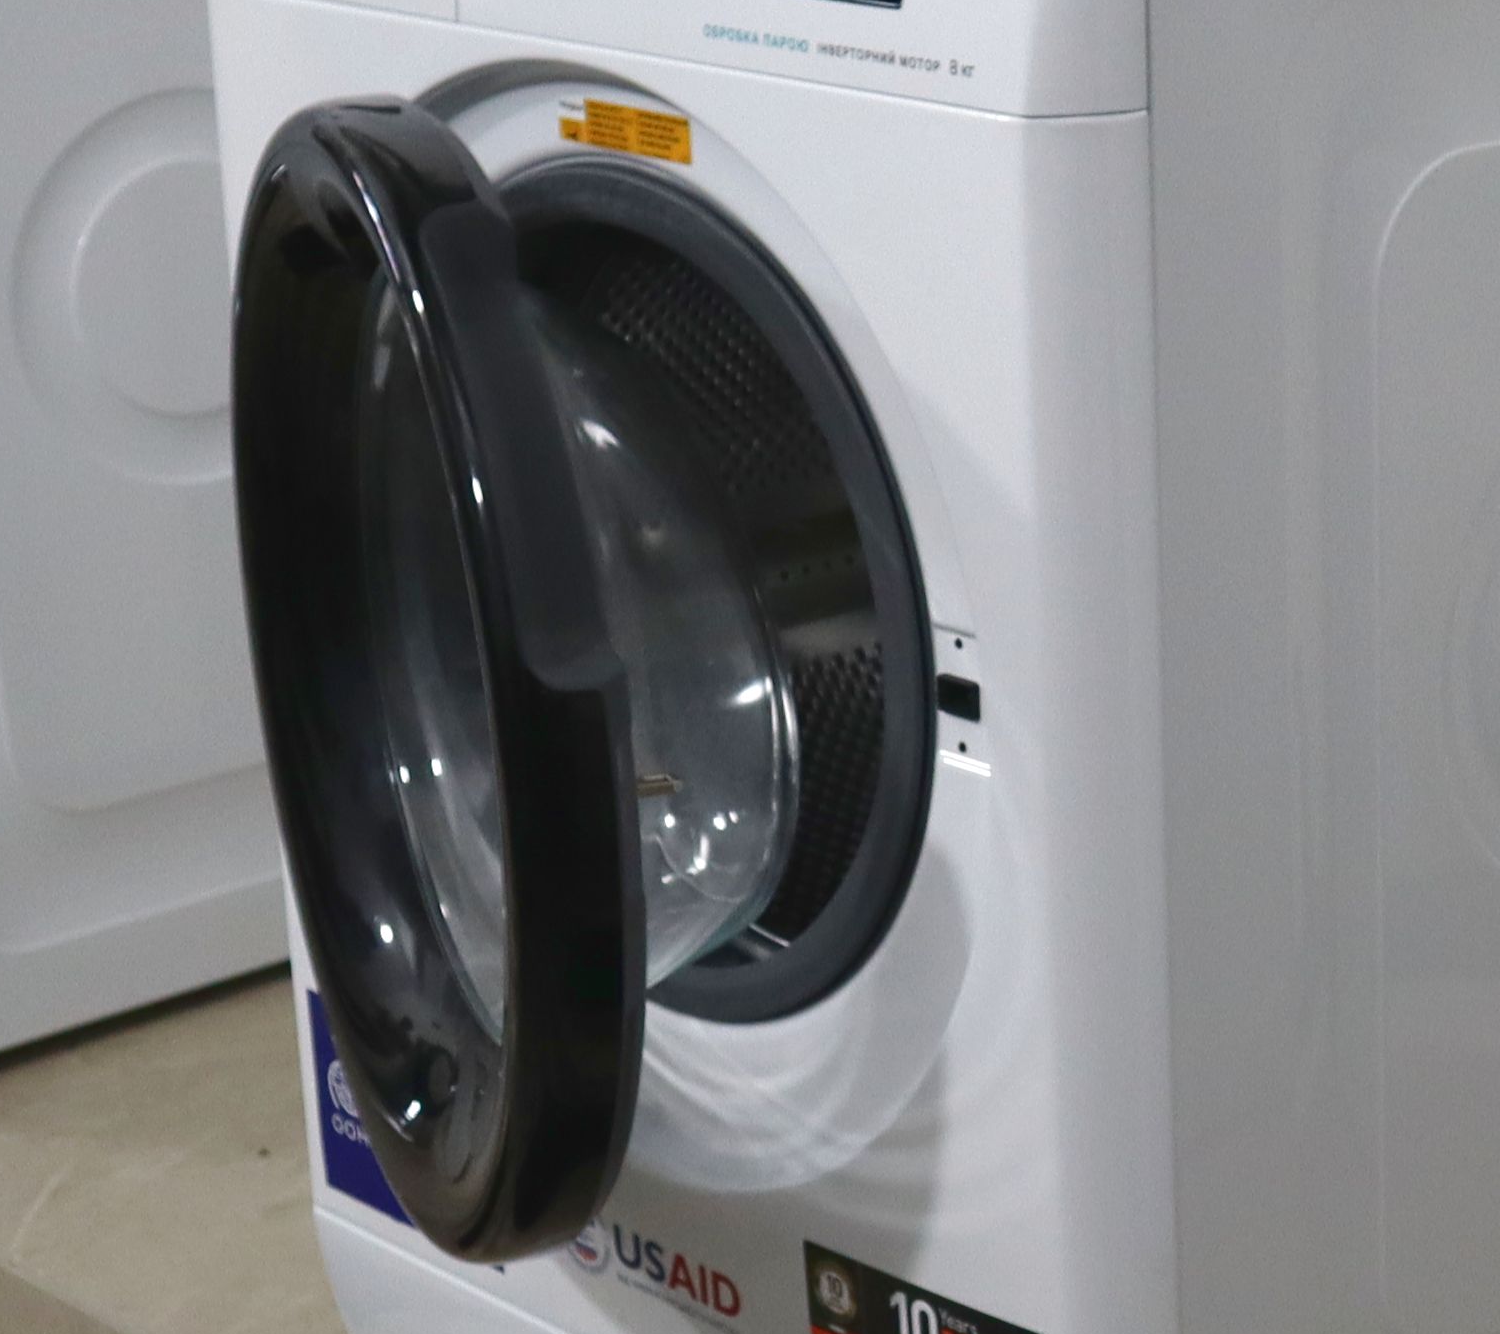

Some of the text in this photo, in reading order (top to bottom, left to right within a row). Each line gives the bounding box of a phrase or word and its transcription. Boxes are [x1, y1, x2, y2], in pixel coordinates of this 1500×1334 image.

[703, 23, 760, 45] ОБРОБКА
[899, 53, 941, 73] МОТОР
[613, 1222, 742, 1317] USAID
